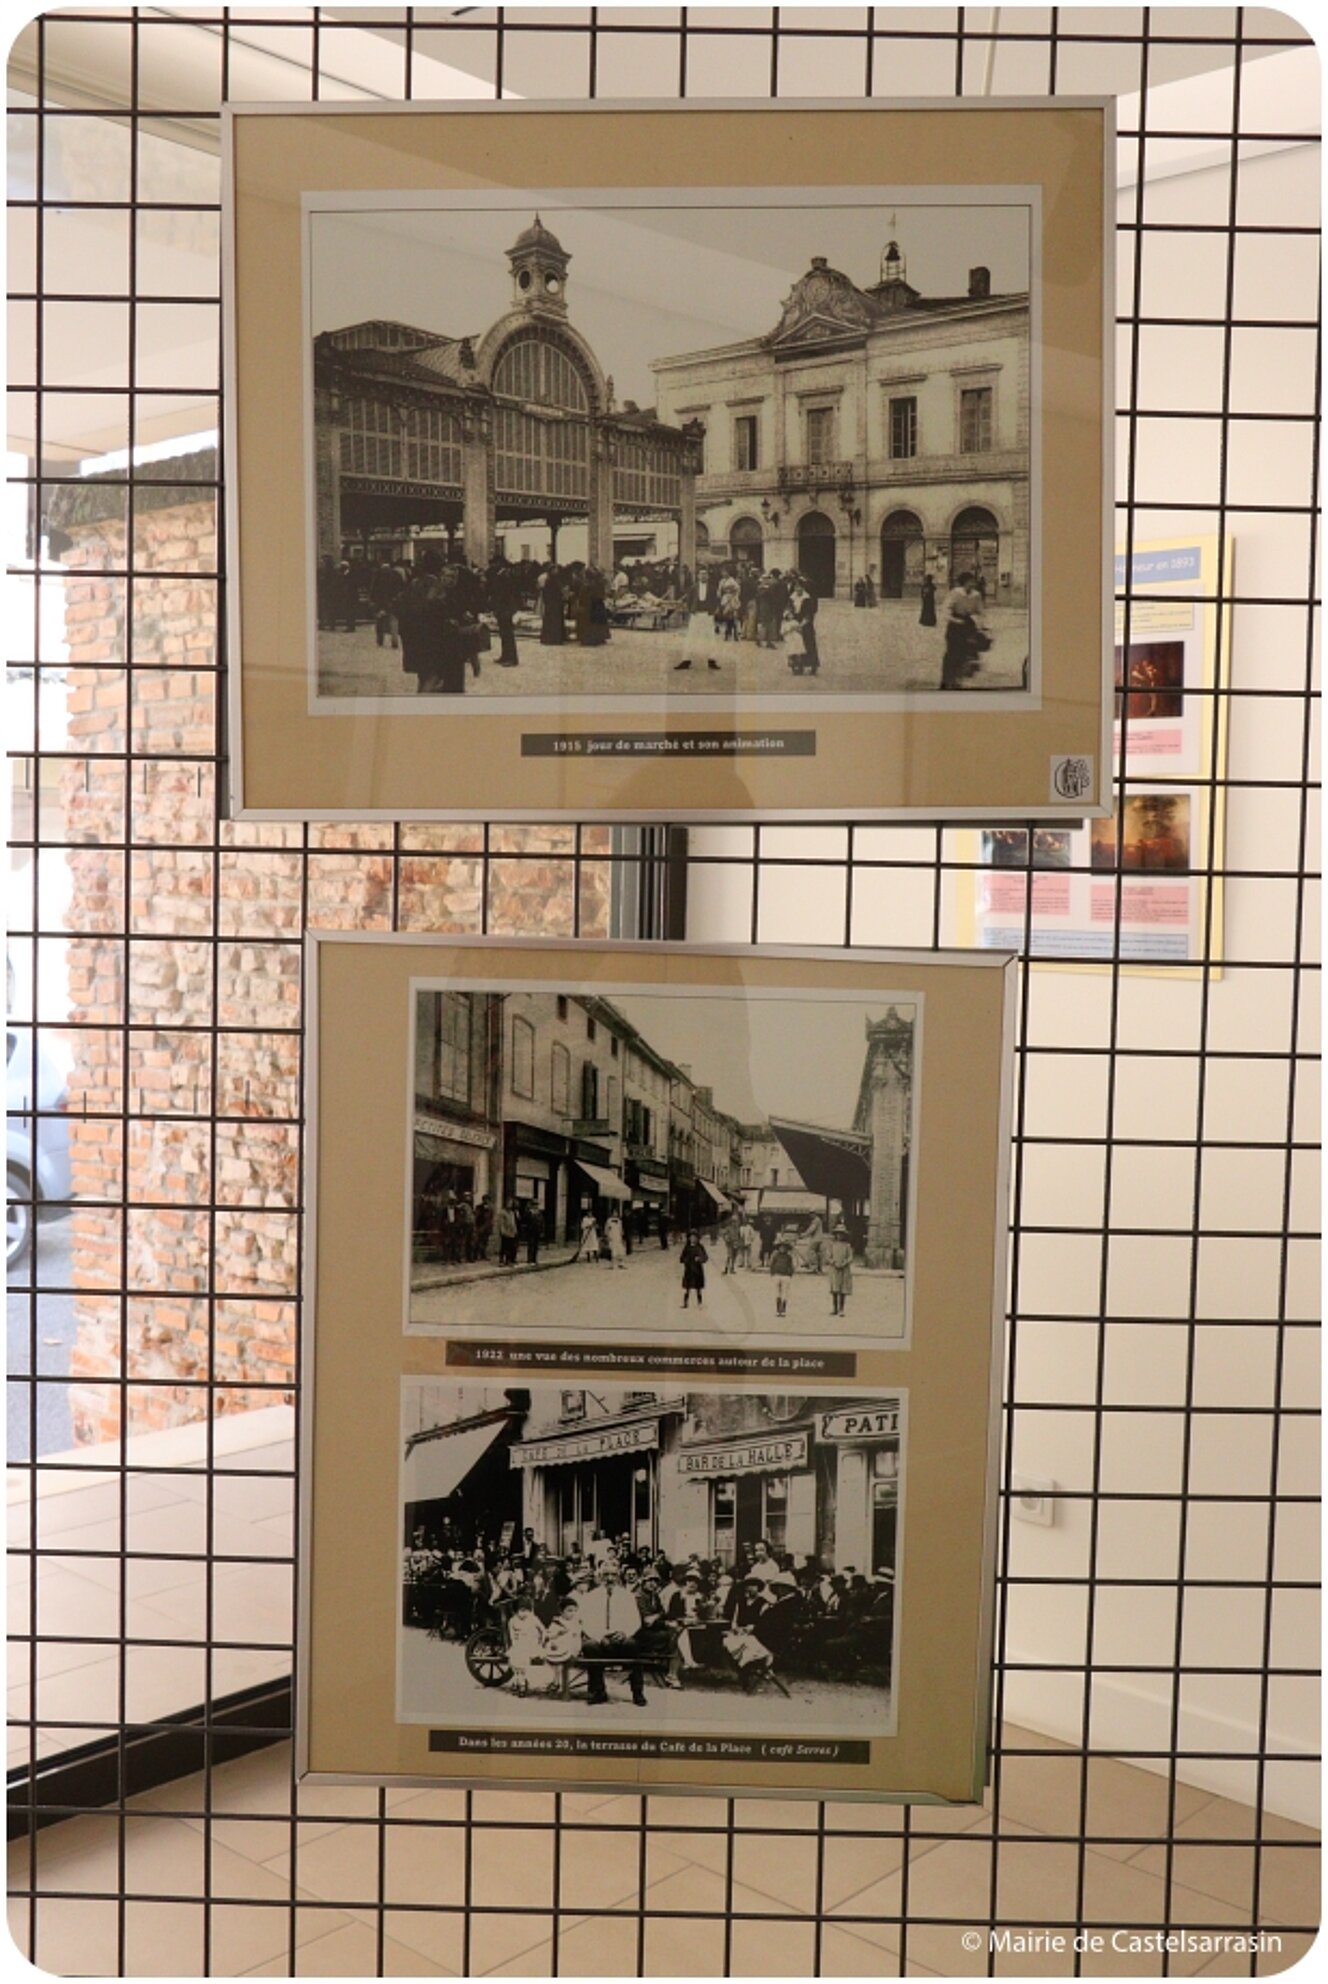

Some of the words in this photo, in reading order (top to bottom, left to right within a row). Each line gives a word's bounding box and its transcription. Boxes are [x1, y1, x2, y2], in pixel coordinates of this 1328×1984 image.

[553, 740, 583, 752] 1915
[586, 740, 613, 754] jour
[615, 740, 631, 750] de
[634, 739, 679, 750] marché
[682, 740, 695, 750] et
[697, 740, 720, 750] son
[722, 737, 785, 750] animation
[476, 1349, 504, 1360] 1922
[509, 1352, 533, 1362] une
[535, 1353, 557, 1362] vue
[559, 1351, 580, 1363] des
[583, 1352, 645, 1364] nombreux
[648, 1354, 715, 1366] commerces
[718, 1356, 757, 1367] autour
[760, 1357, 776, 1368] de
[778, 1357, 791, 1368] la
[792, 1357, 825, 1370] place
[844, 1413, 898, 1434] PATI
[600, 1430, 639, 1450] PLACE
[686, 1454, 708, 1471] BAR
[750, 1443, 793, 1464] HALLE
[458, 1736, 488, 1748] Dans
[490, 1737, 507, 1748] les
[510, 1738, 551, 1749] années
[576, 1739, 588, 1750] la
[590, 1740, 637, 1751] terrasse
[660, 1741, 685, 1753] Café
[688, 1742, 703, 1753] de
[706, 1743, 718, 1753] la
[720, 1743, 752, 1755] Place
